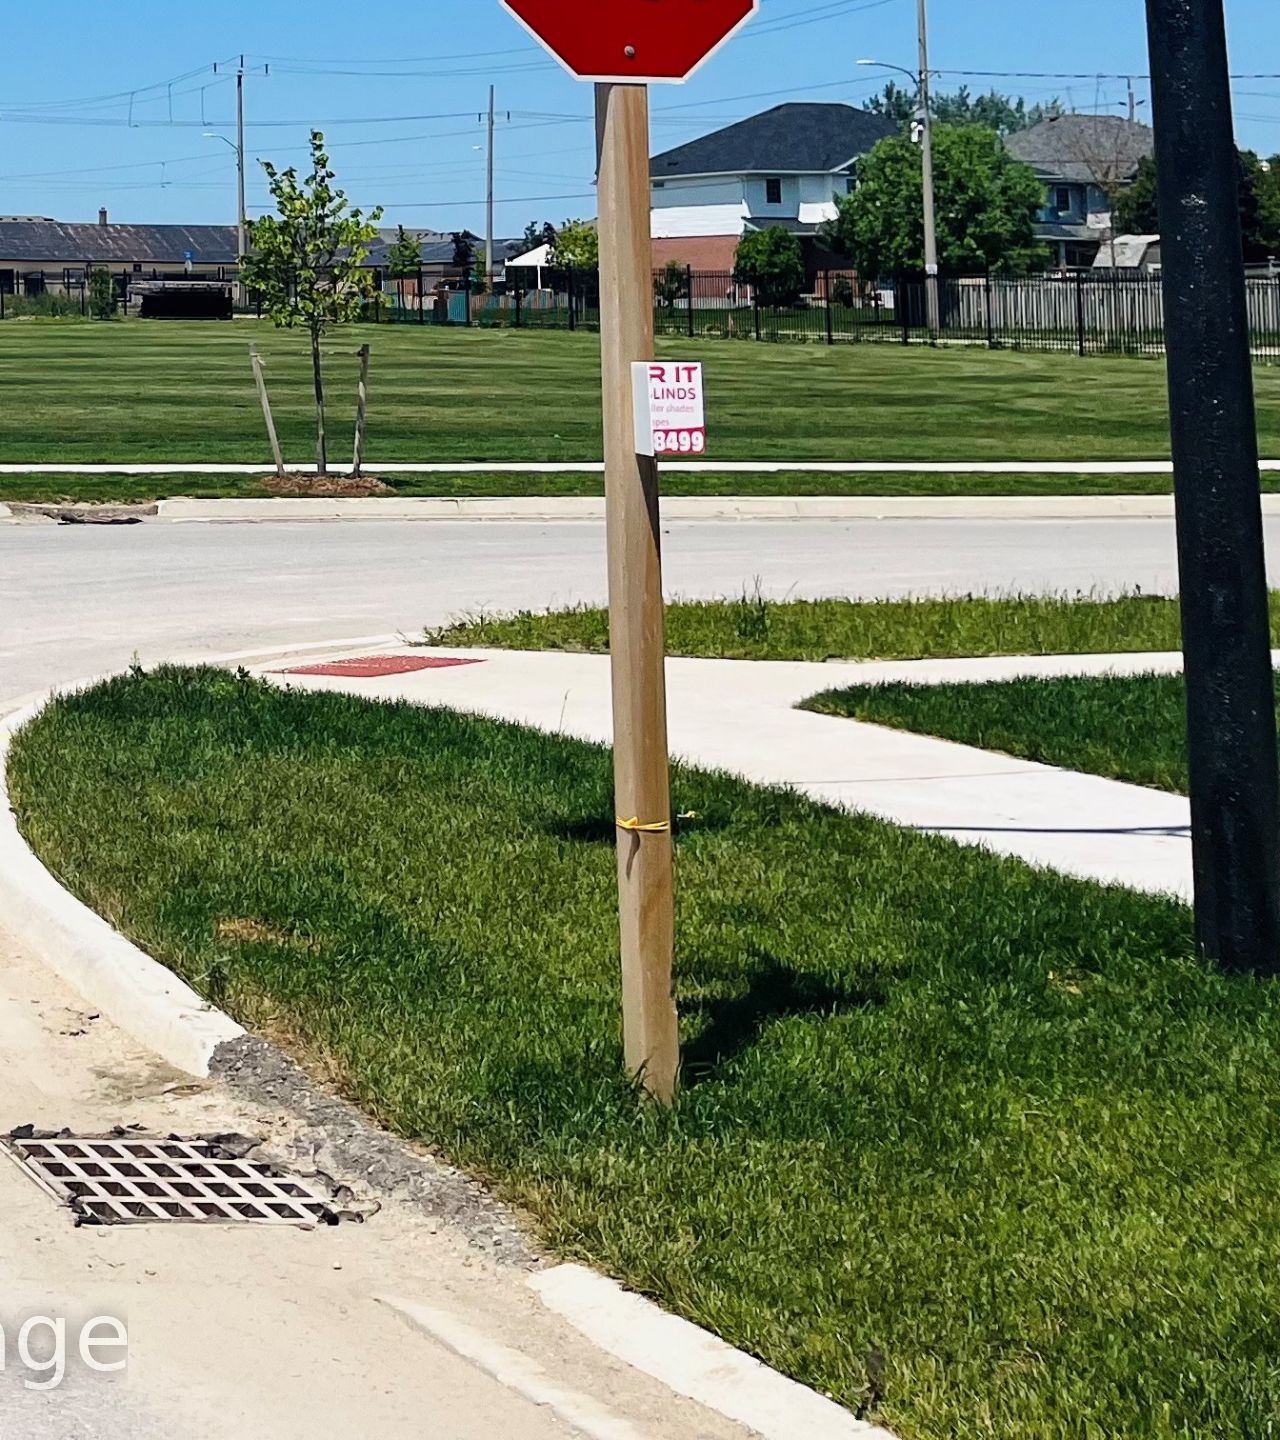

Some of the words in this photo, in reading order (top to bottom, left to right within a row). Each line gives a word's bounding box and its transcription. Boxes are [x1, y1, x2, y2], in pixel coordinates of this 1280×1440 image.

[675, 366, 698, 383] IT
[651, 387, 696, 400] LINDS
[654, 431, 704, 452] 8499
